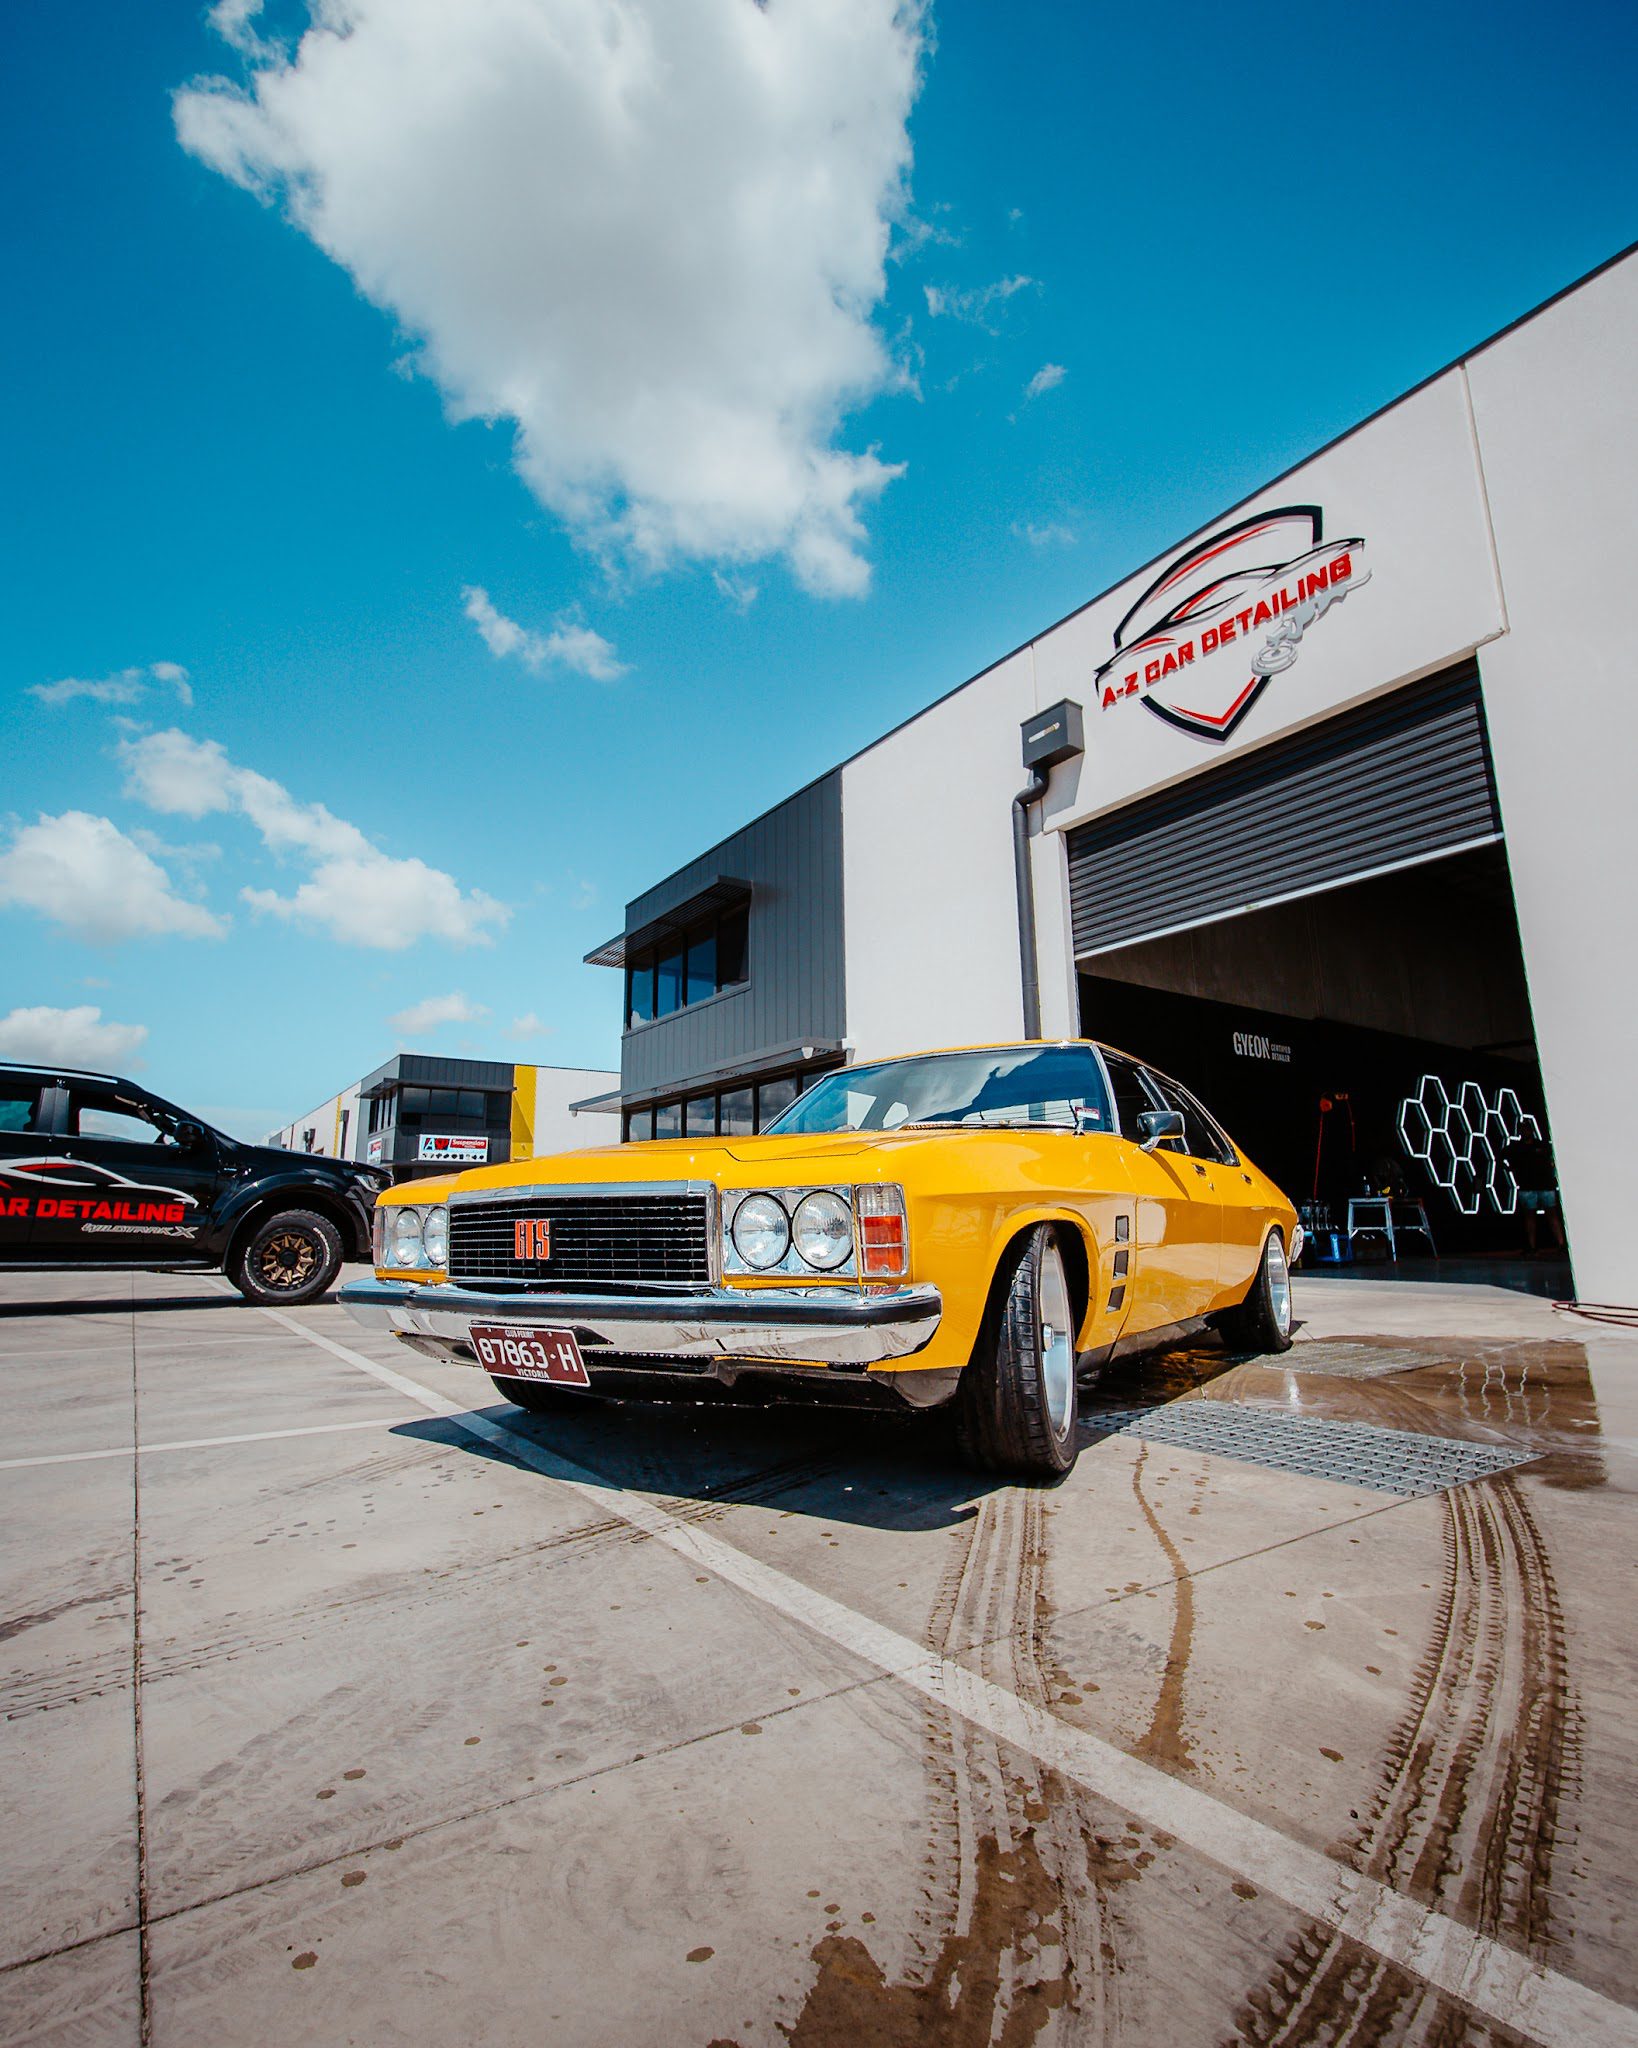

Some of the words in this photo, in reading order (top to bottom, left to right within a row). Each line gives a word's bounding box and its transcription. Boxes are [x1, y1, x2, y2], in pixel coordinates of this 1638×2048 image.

[1102, 671, 1139, 708] A-Z
[1145, 641, 1195, 683] CAR
[1201, 553, 1352, 653] DETAILING
[1233, 1031, 1270, 1059] GYEON
[36, 1199, 185, 1222] DETAILING
[514, 1218, 550, 1260] GTS
[516, 1368, 550, 1380] VICTORIA
